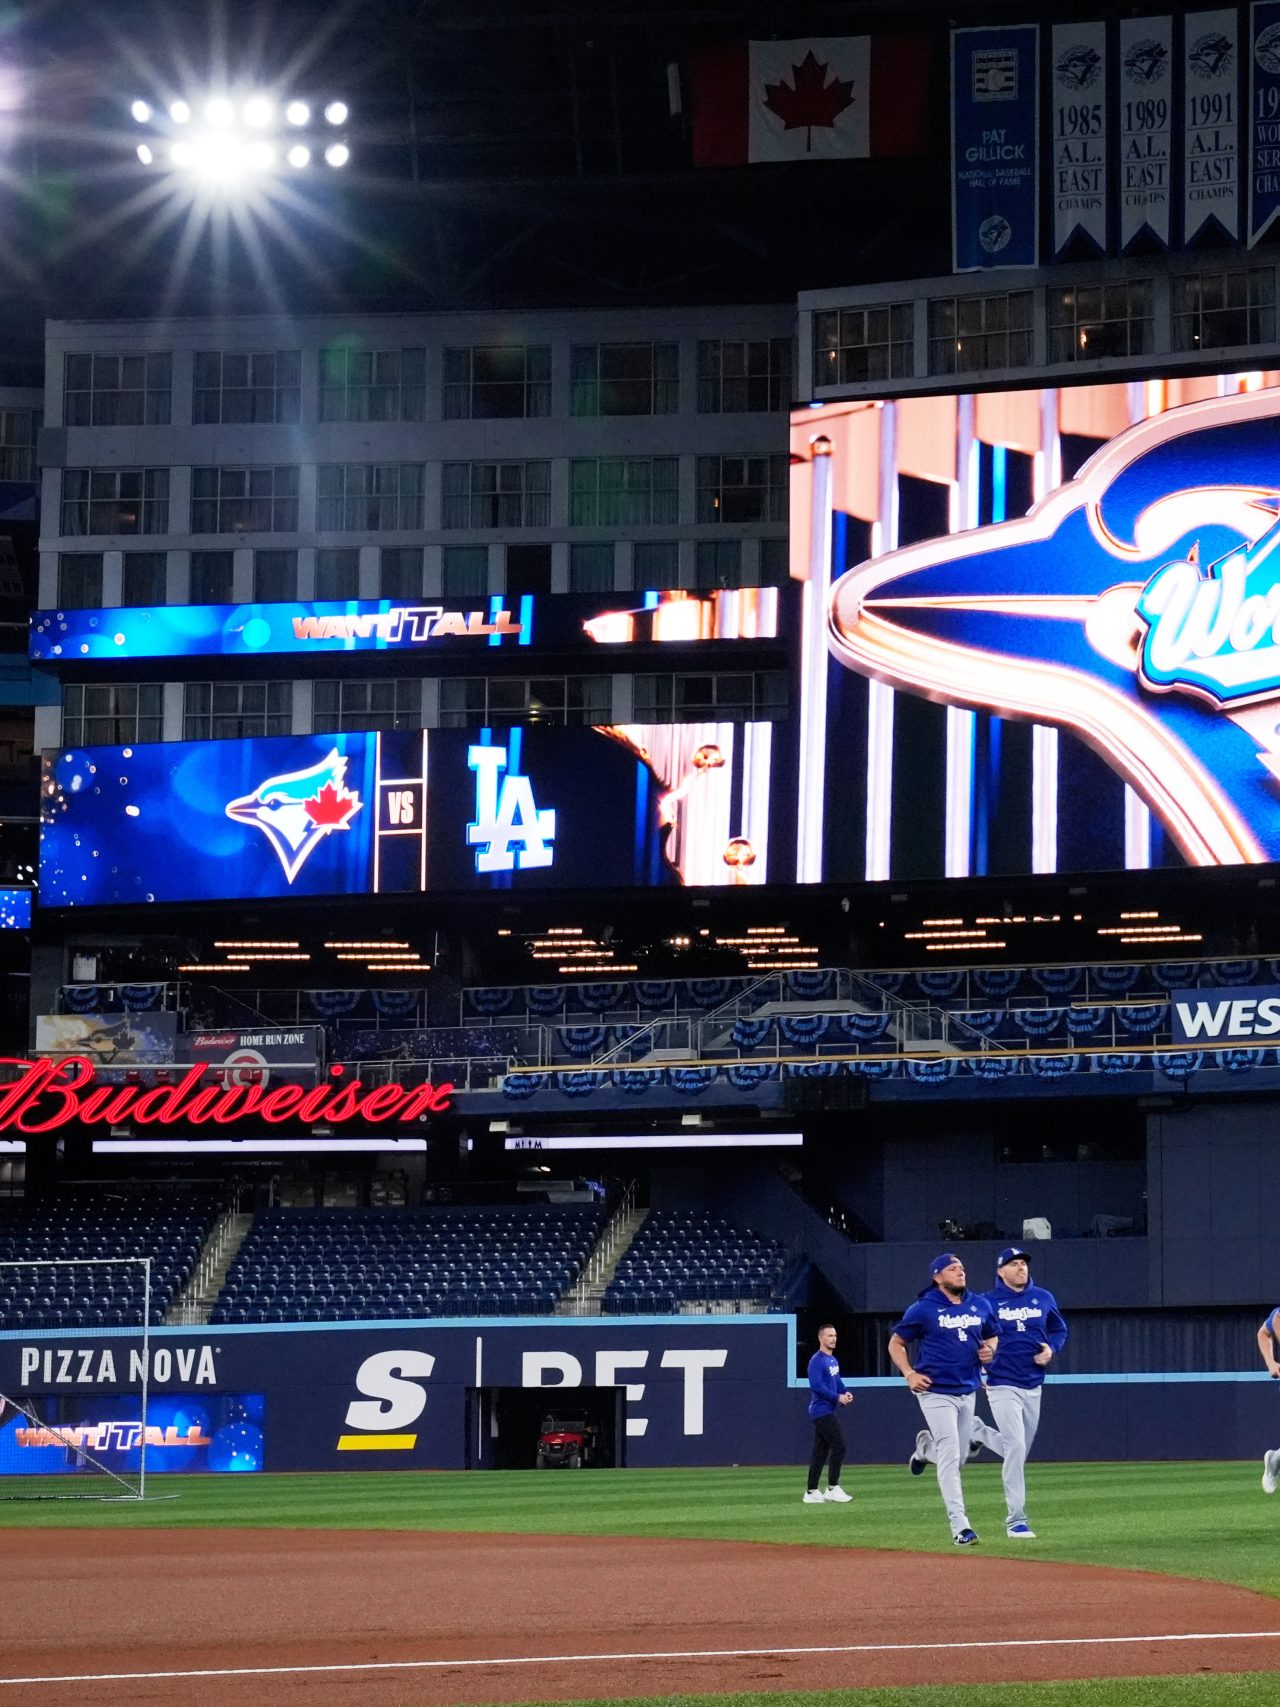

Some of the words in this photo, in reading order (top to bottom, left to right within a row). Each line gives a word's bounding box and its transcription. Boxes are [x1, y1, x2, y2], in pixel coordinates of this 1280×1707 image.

[1059, 105, 1102, 136] 1985
[1126, 99, 1167, 131] 1989
[1191, 93, 1233, 126] 1991
[982, 129, 1007, 144] PAT
[1126, 136, 1166, 159] A.L.
[1191, 131, 1234, 154] A.L.
[965, 145, 1025, 162] GILLICK
[1059, 142, 1101, 164] A.L.
[995, 167, 1032, 177] BASEBALL
[1059, 169, 1102, 193] EAST
[1126, 163, 1167, 188] EAST
[1191, 157, 1234, 183] EAST
[987, 178, 999, 187] OF
[1000, 177, 1022, 186] FAME
[1058, 197, 1102, 211] CHAMPS
[1125, 193, 1167, 207] CHAMPS
[1190, 187, 1234, 201] CHAMPS
[292, 614, 396, 640] WANT
[430, 611, 523, 636] ALL
[387, 790, 415, 825] VS
[466, 745, 556, 873] LA
[192, 1036, 237, 1048] Budweiser
[240, 1035, 264, 1047] HOME
[265, 1034, 282, 1046] RUN
[283, 1033, 305, 1046] ZONE
[0, 1056, 456, 1135] Budweiser
[21, 1347, 117, 1386] PIZZA
[129, 1345, 218, 1384] NOVA
